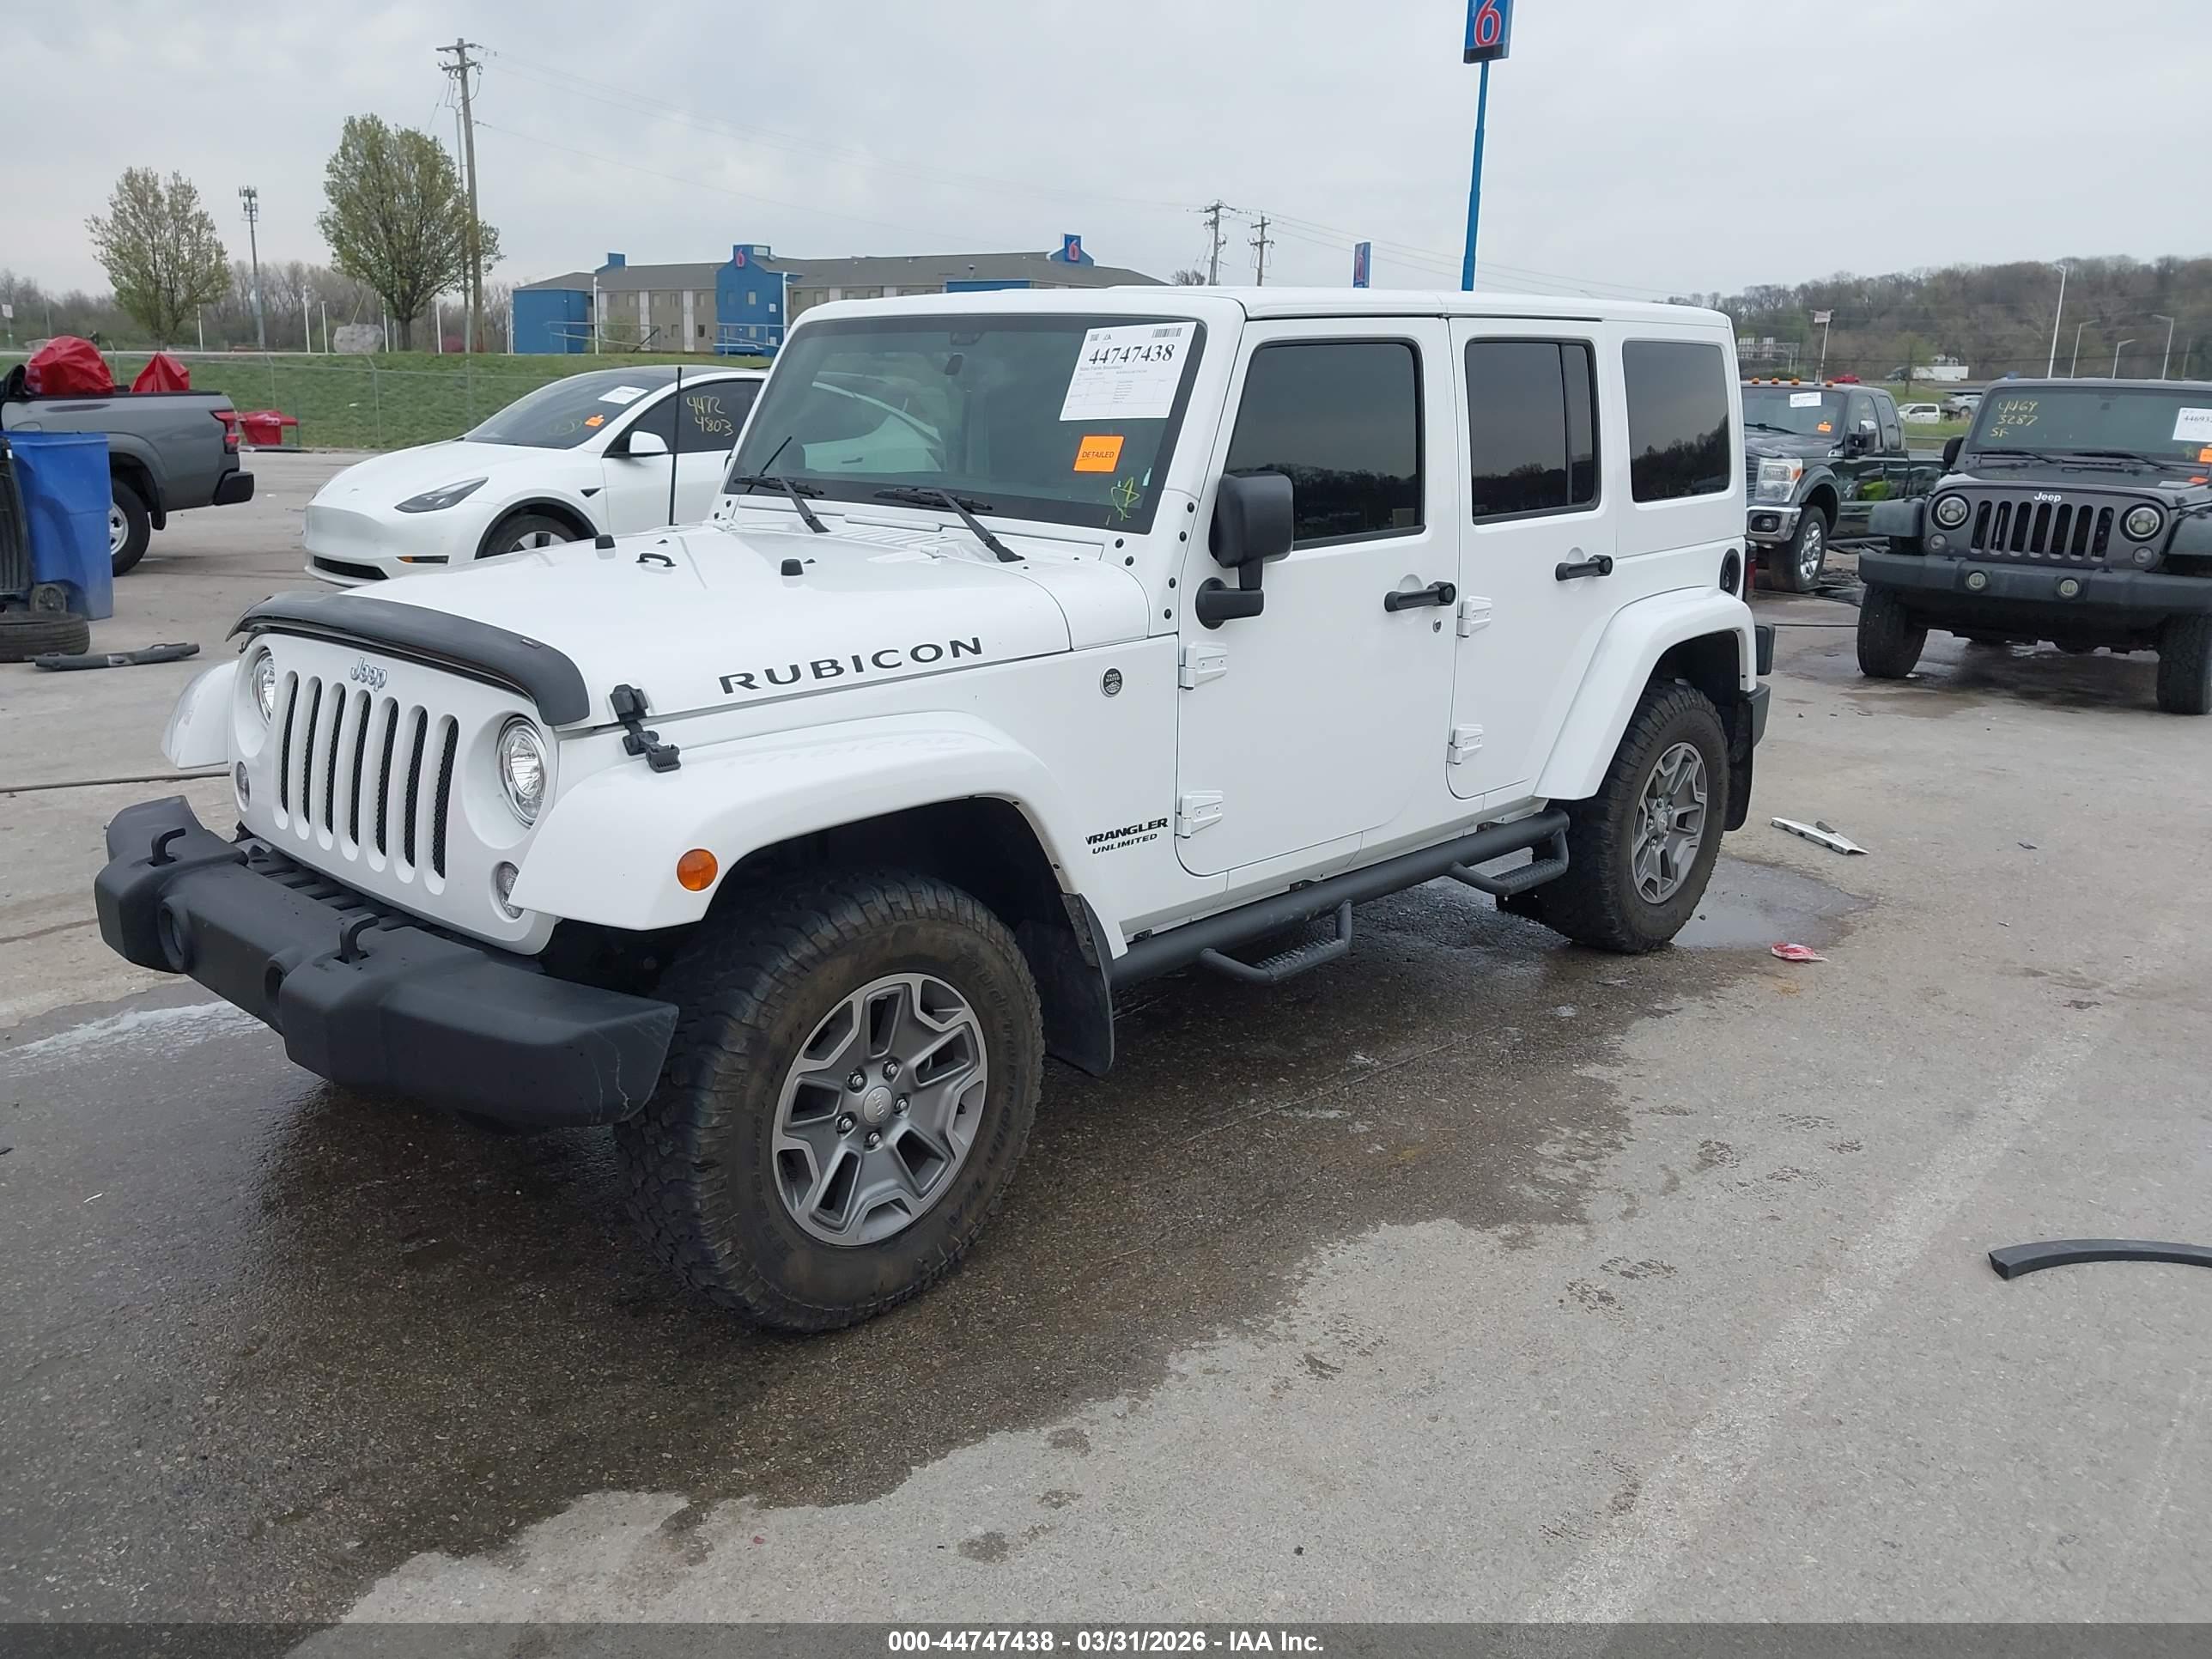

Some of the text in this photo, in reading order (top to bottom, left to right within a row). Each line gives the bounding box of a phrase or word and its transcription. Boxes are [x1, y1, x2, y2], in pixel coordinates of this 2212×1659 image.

[1474, 0, 1502, 46] 6
[1088, 343, 1176, 365] 44747438
[695, 416, 734, 436] 4803
[2034, 492, 2062, 503] Jeep
[350, 656, 388, 692] Jeep
[719, 637, 983, 695] RUBICON
[1092, 833, 1158, 854] UNLIMITED
